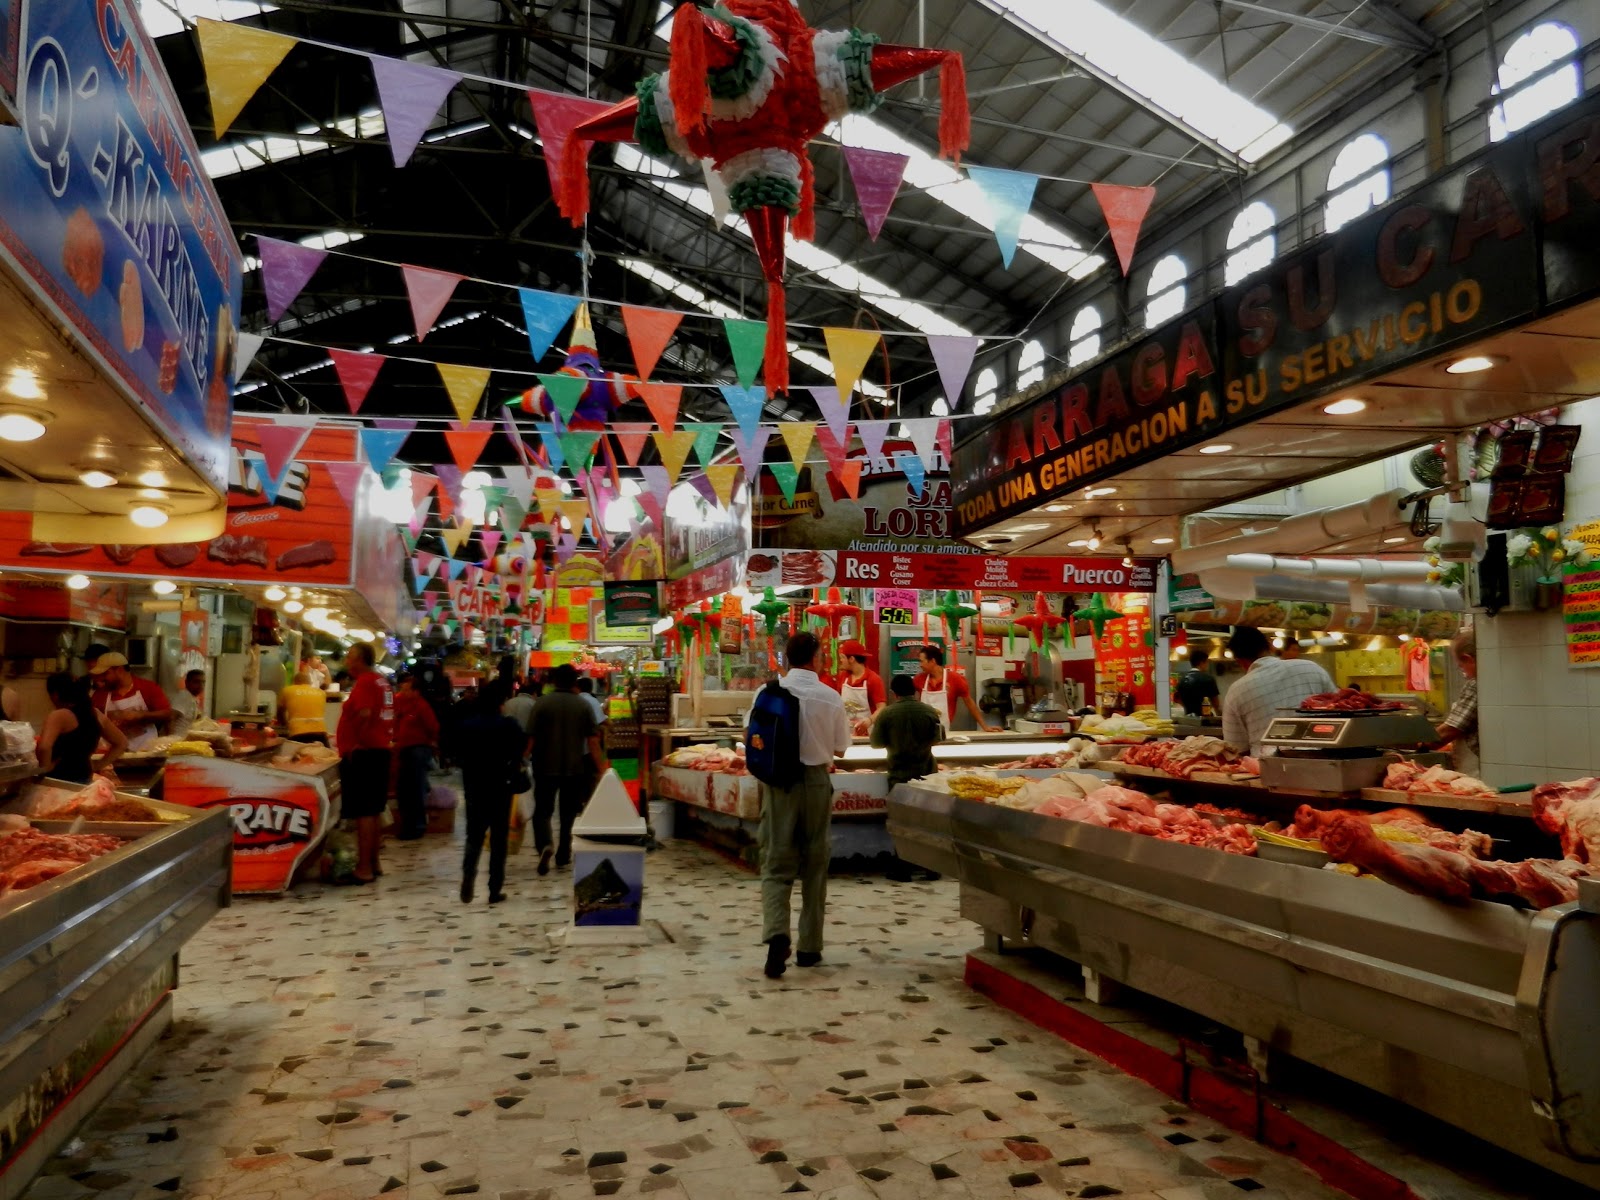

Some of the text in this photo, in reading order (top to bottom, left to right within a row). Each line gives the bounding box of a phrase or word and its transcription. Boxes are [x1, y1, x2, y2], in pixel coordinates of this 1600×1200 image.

[1238, 247, 1337, 358] SU
[957, 279, 1482, 526] TODA UNA GENERACION A SU SERVICIO
[864, 508, 952, 539] LOR
[847, 539, 897, 552] Atendido
[900, 542, 918, 552] por
[922, 543, 934, 552] su
[936, 543, 969, 554] amigo
[845, 558, 880, 579] Res
[892, 556, 912, 564] Bistec
[984, 558, 1008, 566] Chuleta
[974, 579, 1018, 588] Cabeza Cocida
[1063, 563, 1125, 585] Puerco
[229, 803, 310, 836] RATE
